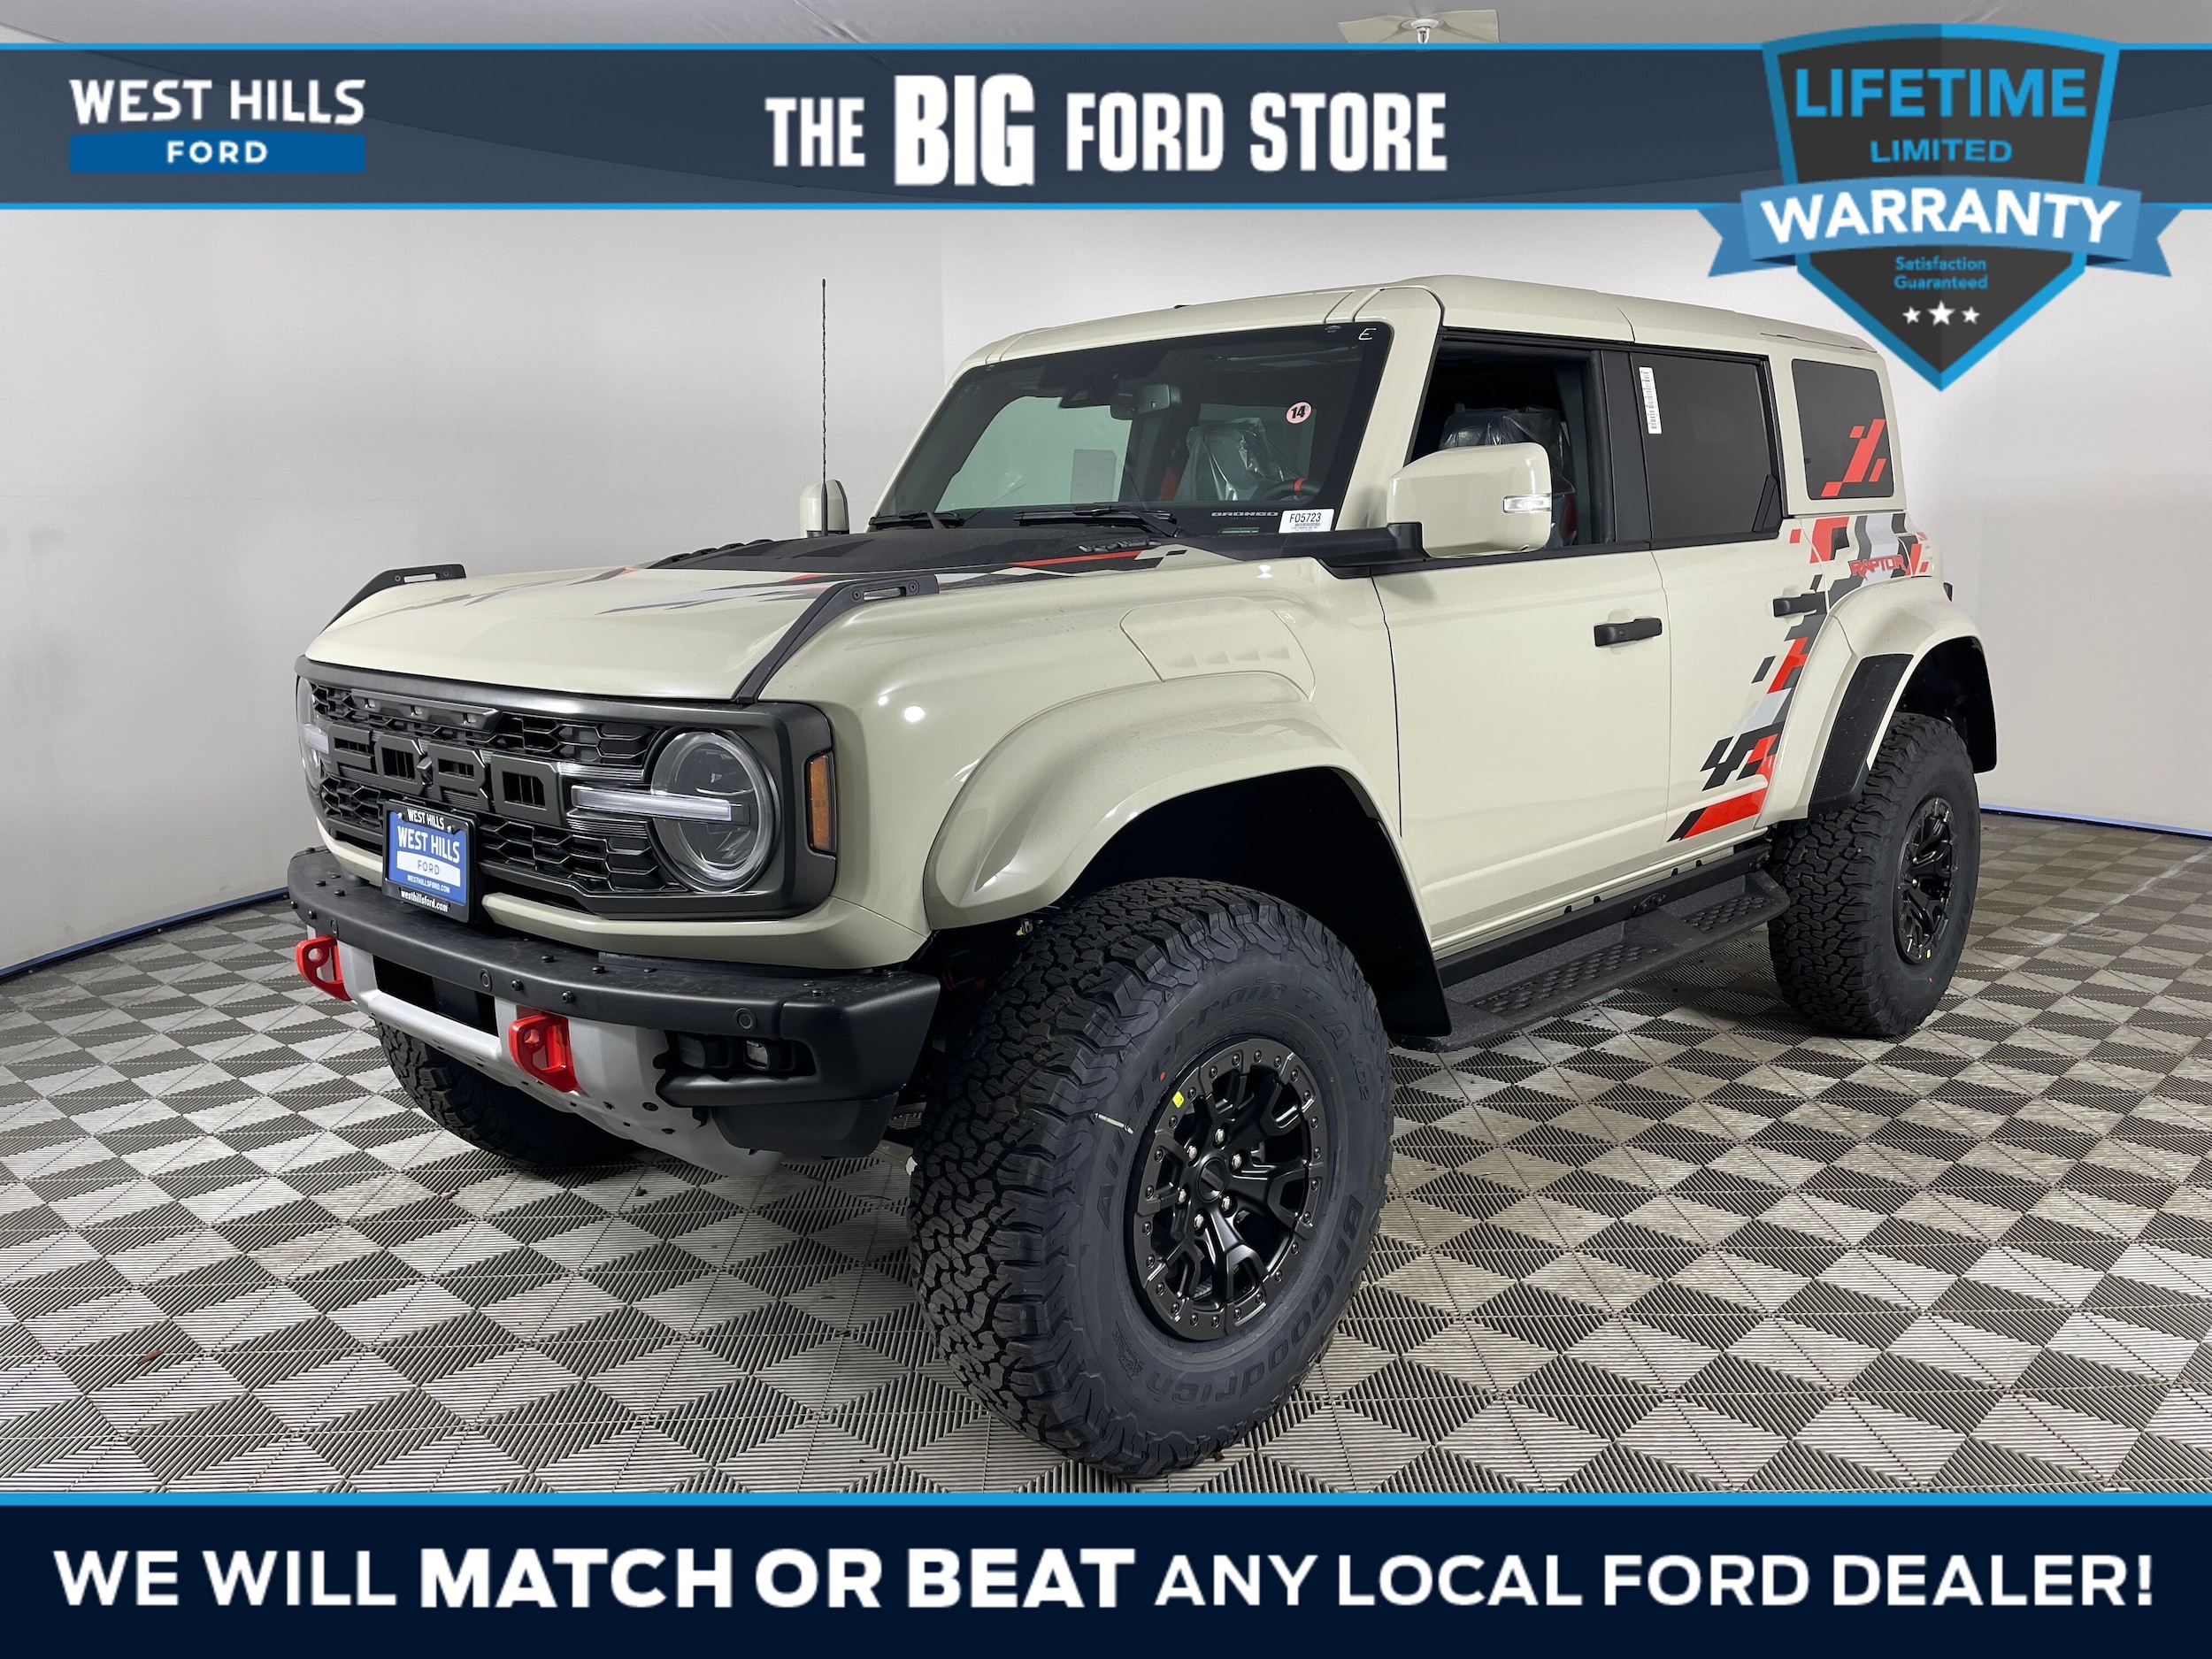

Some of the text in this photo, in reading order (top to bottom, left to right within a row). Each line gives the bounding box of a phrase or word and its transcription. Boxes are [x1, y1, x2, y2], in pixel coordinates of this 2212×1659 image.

[1291, 405, 1306, 419] 14
[1848, 554, 1909, 578] RAPTOR
[327, 723, 565, 827] FORD
[407, 809, 444, 831] WEST HILLS
[397, 826, 460, 864] WEST HILLS
[417, 859, 441, 875] FORD
[407, 874, 450, 894] WESTHILLSFORD.COM
[401, 889, 449, 912] westhillsford.com
